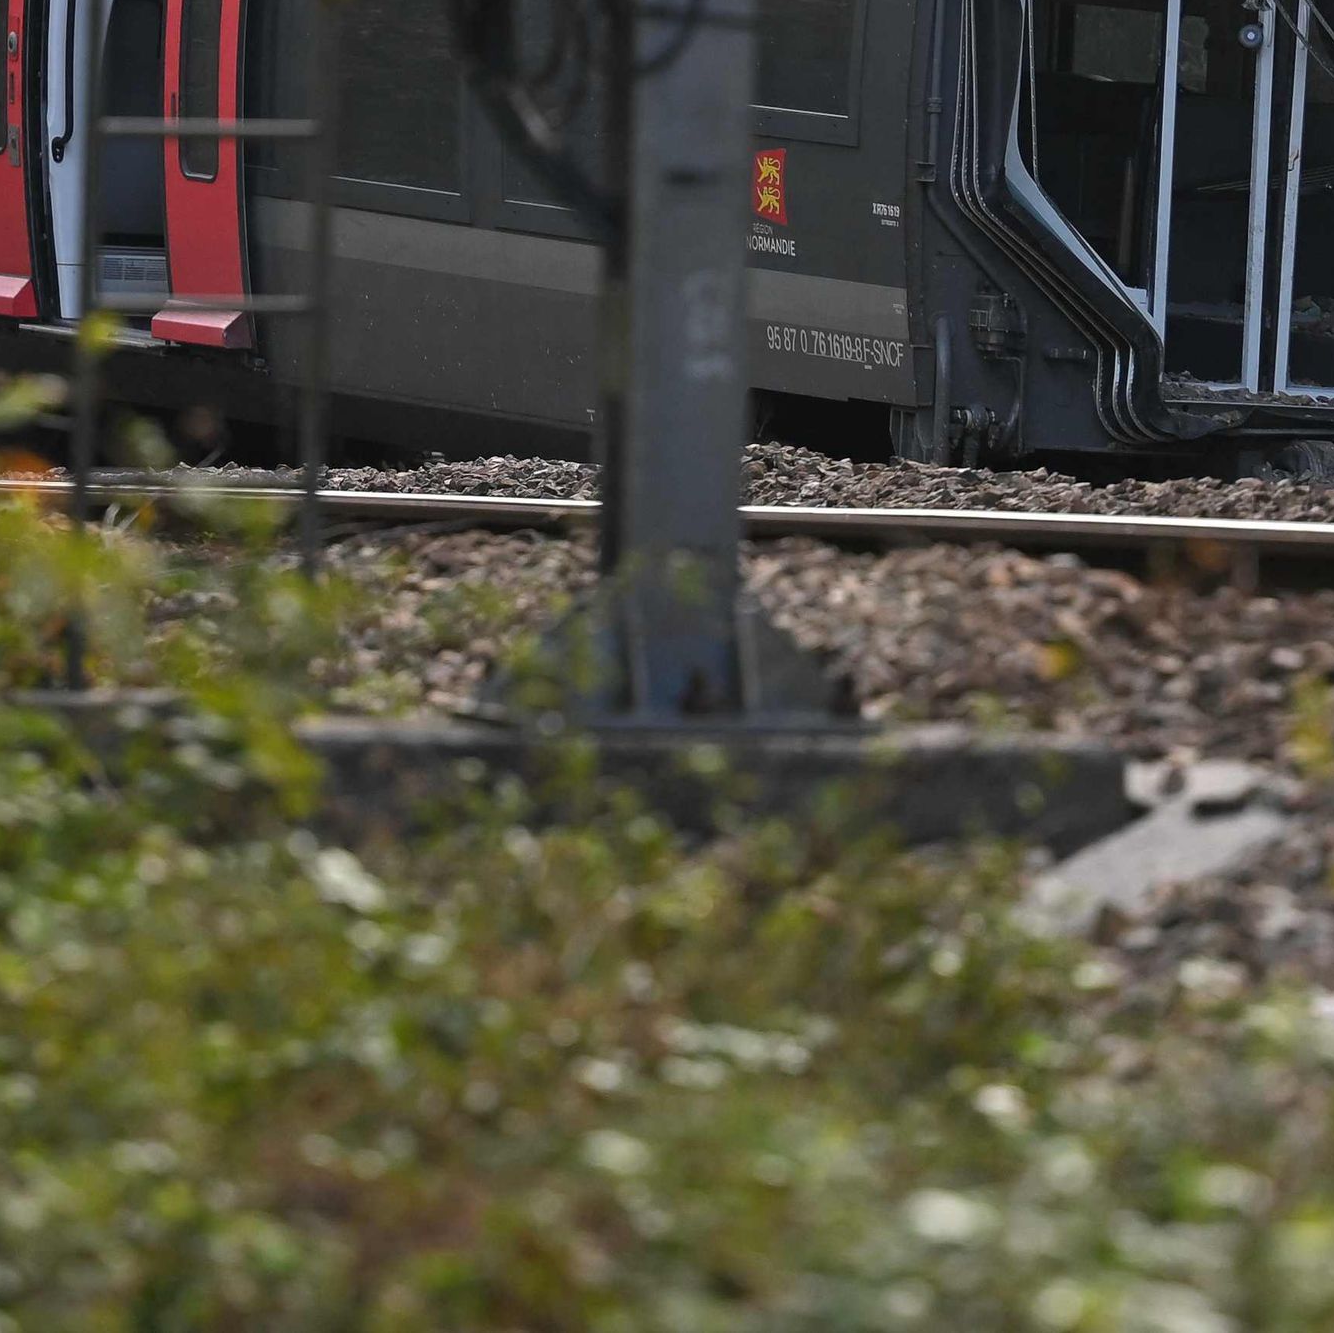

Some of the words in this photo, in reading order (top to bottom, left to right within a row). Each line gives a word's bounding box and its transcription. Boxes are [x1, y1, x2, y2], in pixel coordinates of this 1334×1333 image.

[747, 235, 796, 256] NORMANDIE
[767, 325, 781, 350] 95
[784, 327, 797, 352] 87
